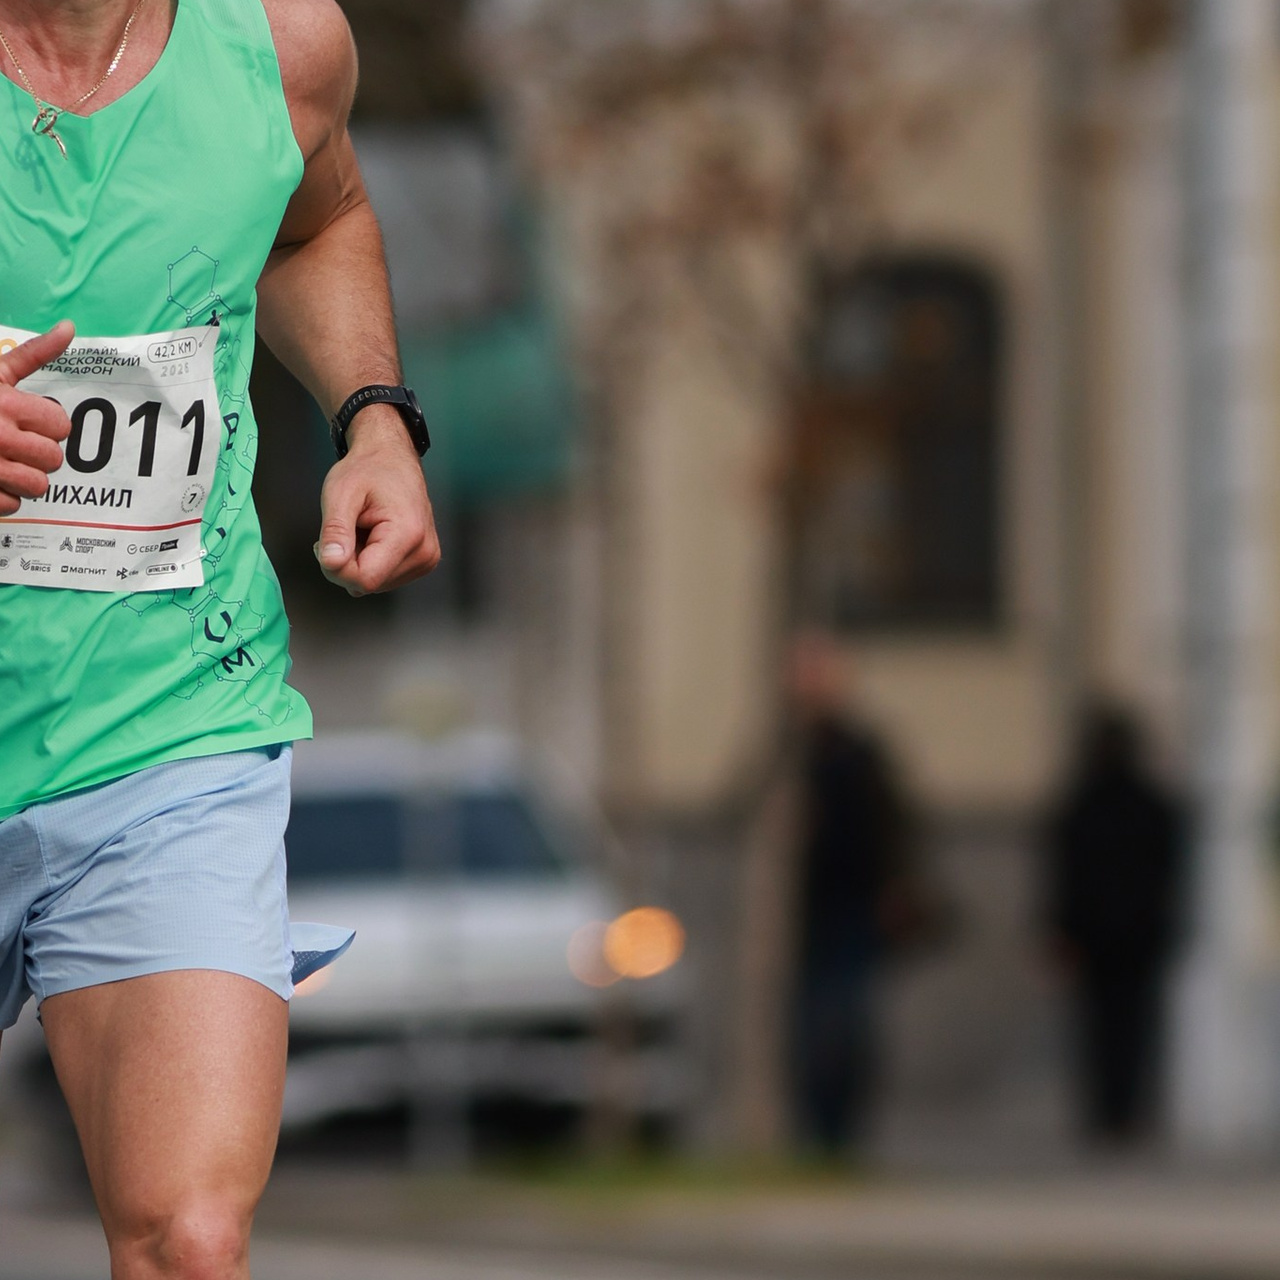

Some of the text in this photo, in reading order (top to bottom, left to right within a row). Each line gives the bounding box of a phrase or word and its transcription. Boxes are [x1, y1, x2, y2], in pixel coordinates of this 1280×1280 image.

[63, 346, 118, 355] ЕРПРАЙМ
[155, 344, 175, 358] 42,2
[53, 354, 140, 367] ОСКОВСКИЙ
[42, 395, 205, 477] 011
[188, 493, 197, 504] 7
[76, 537, 116, 548] МОСКОВСКИЙ
[75, 545, 94, 554] СПОРТ
[139, 544, 159, 553] СБЕР
[30, 565, 51, 573] BRICS
